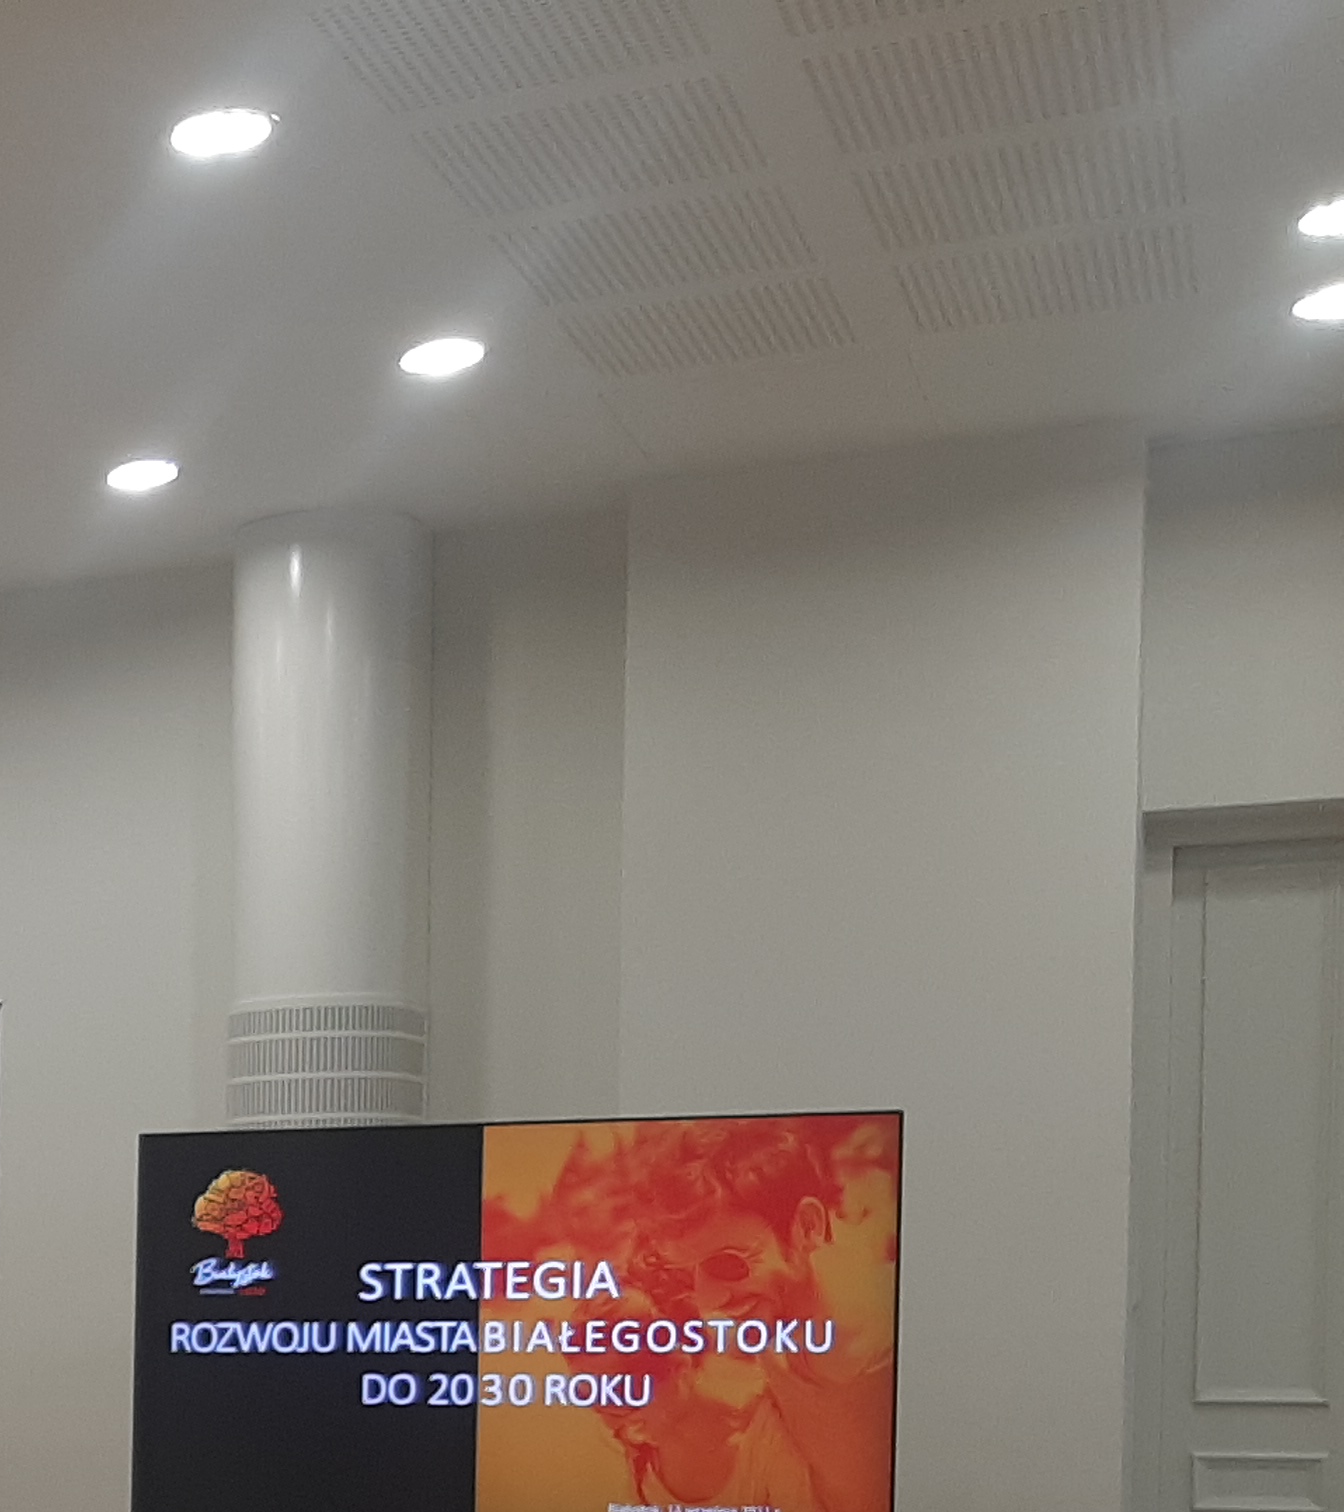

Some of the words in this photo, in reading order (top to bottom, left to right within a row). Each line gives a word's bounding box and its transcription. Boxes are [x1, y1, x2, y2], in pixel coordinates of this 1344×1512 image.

[358, 1261, 619, 1300] STRATEGIA
[170, 1322, 337, 1353] ROZWOJU
[346, 1321, 477, 1353] MIASTA
[483, 1319, 834, 1353] BIAŁEGOSTOKU
[361, 1374, 416, 1405] DO
[428, 1374, 533, 1406] 2030
[545, 1374, 652, 1407] ROKU
